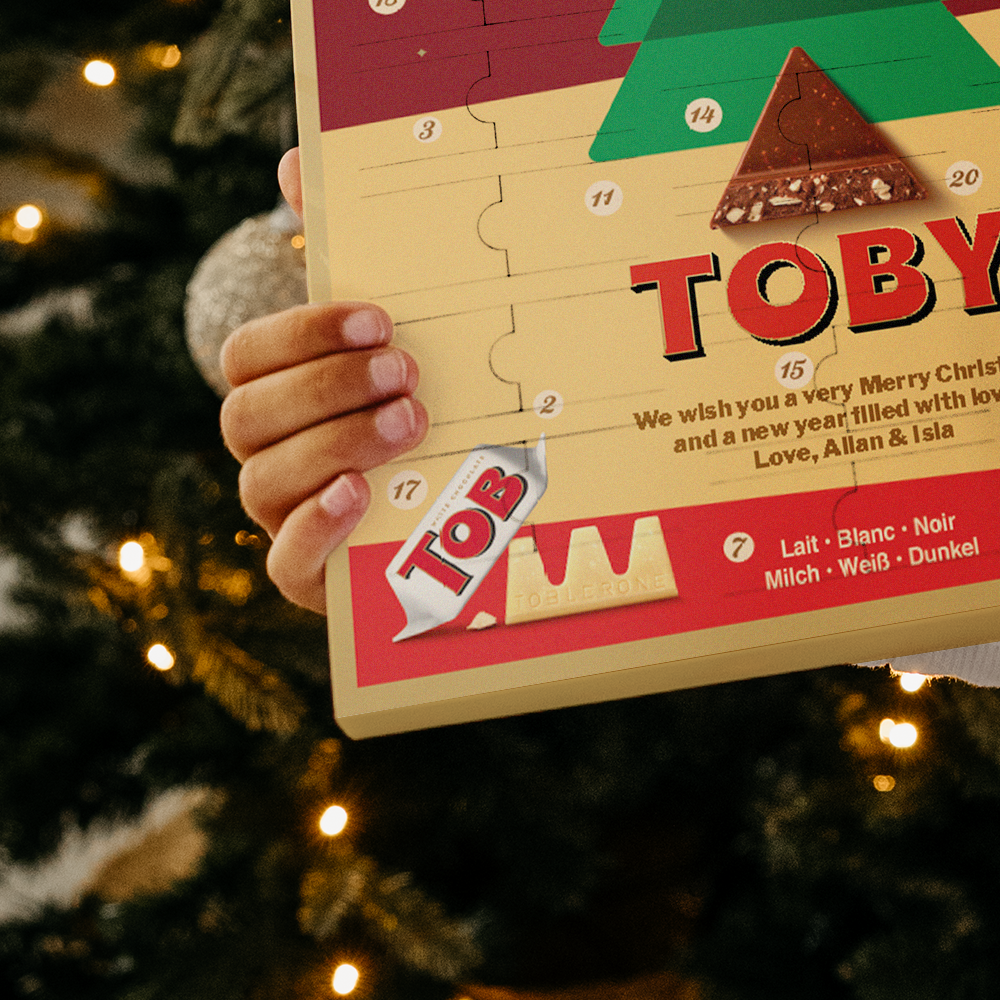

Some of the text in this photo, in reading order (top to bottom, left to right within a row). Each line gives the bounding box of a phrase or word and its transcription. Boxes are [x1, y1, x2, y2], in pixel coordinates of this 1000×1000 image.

[690, 107, 716, 125] 14
[418, 121, 437, 140] 3
[949, 168, 980, 188] 20
[591, 189, 616, 208] 11
[780, 357, 807, 380] 15
[540, 395, 557, 415] 2
[633, 408, 673, 431] We
[735, 394, 780, 419] you
[784, 391, 798, 408] a
[801, 383, 853, 404] very
[859, 374, 931, 396] Merry
[673, 428, 718, 454] and
[722, 429, 736, 446] a
[741, 420, 790, 444] new
[793, 411, 848, 439] year
[753, 421, 955, 470] Love, Allan & Isla
[393, 479, 421, 501] 17
[396, 465, 529, 597] TOB
[780, 512, 956, 559] Lait Blanc Noir
[732, 536, 748, 559] 7
[764, 536, 980, 590] Milch Weiß Dunkel
[513, 572, 667, 612] TOBLERONE
